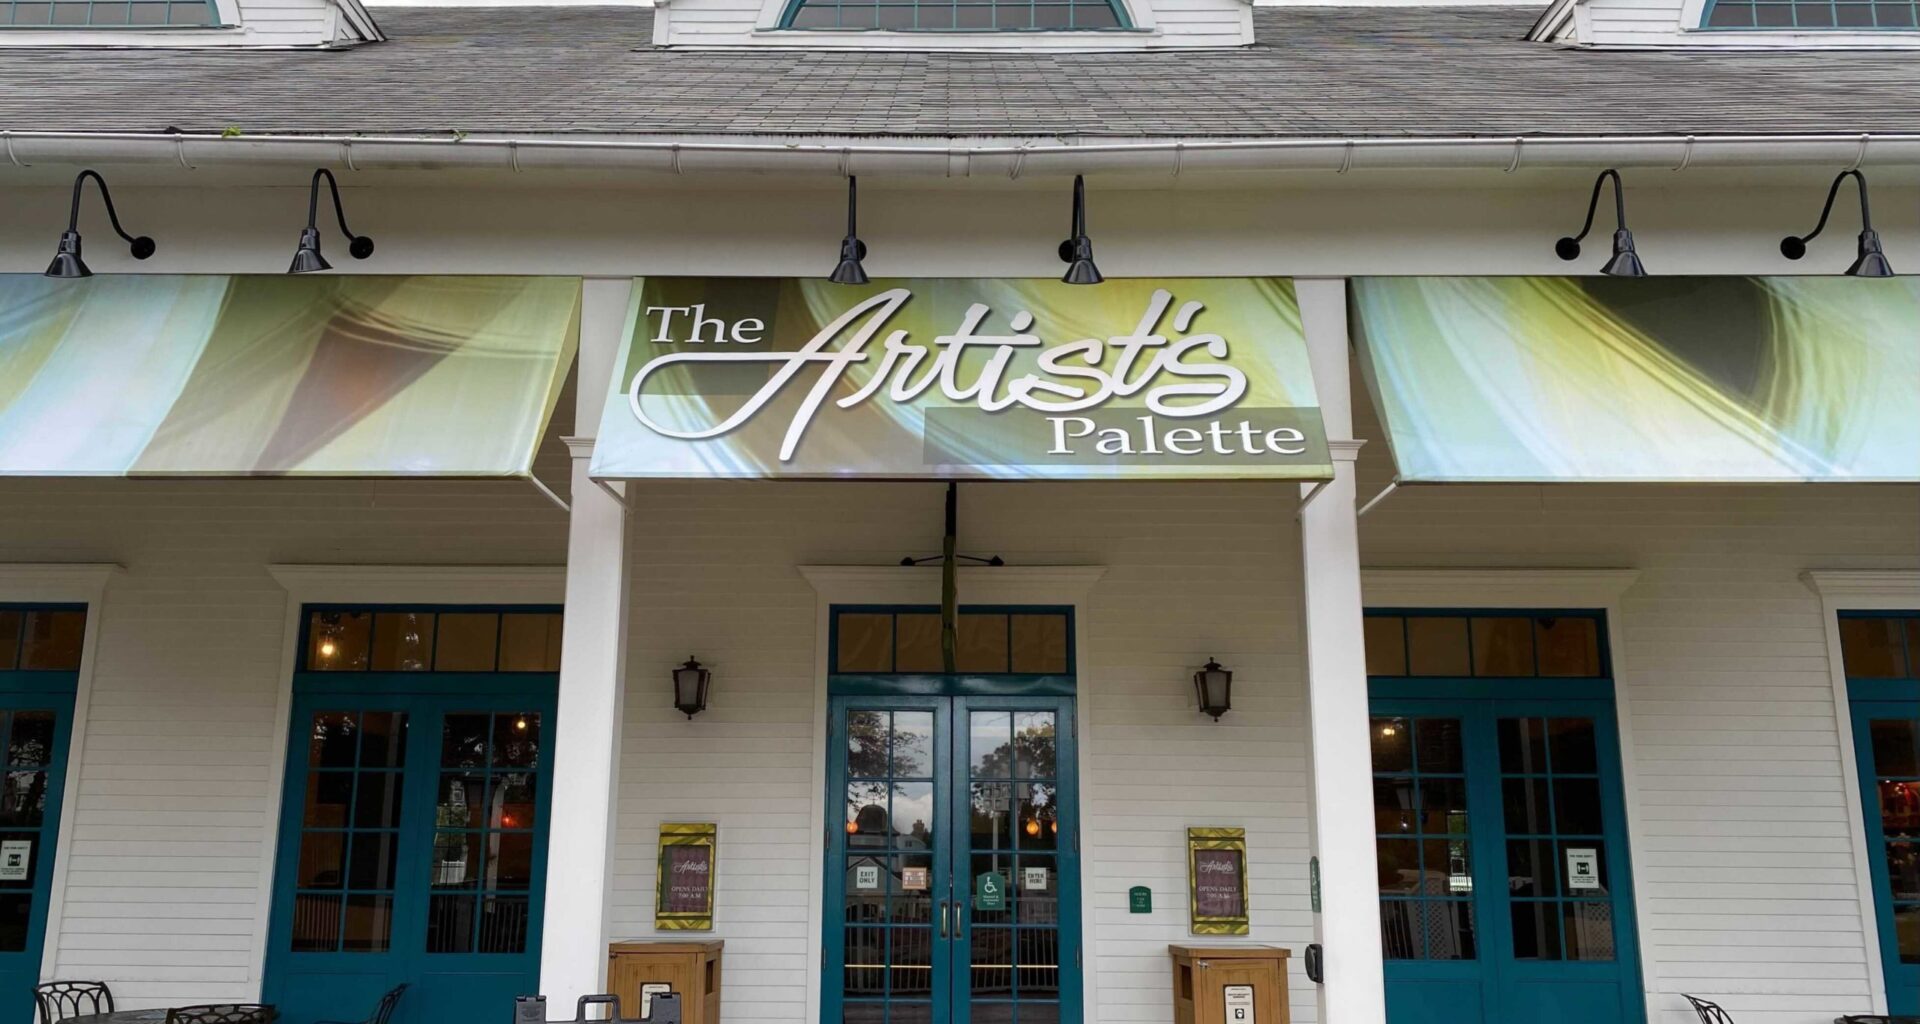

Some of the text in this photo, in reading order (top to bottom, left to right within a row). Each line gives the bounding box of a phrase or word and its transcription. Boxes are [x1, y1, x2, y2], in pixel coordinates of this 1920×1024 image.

[647, 305, 765, 344] The
[628, 288, 1249, 462] Artist's
[1046, 416, 1306, 456] Palette
